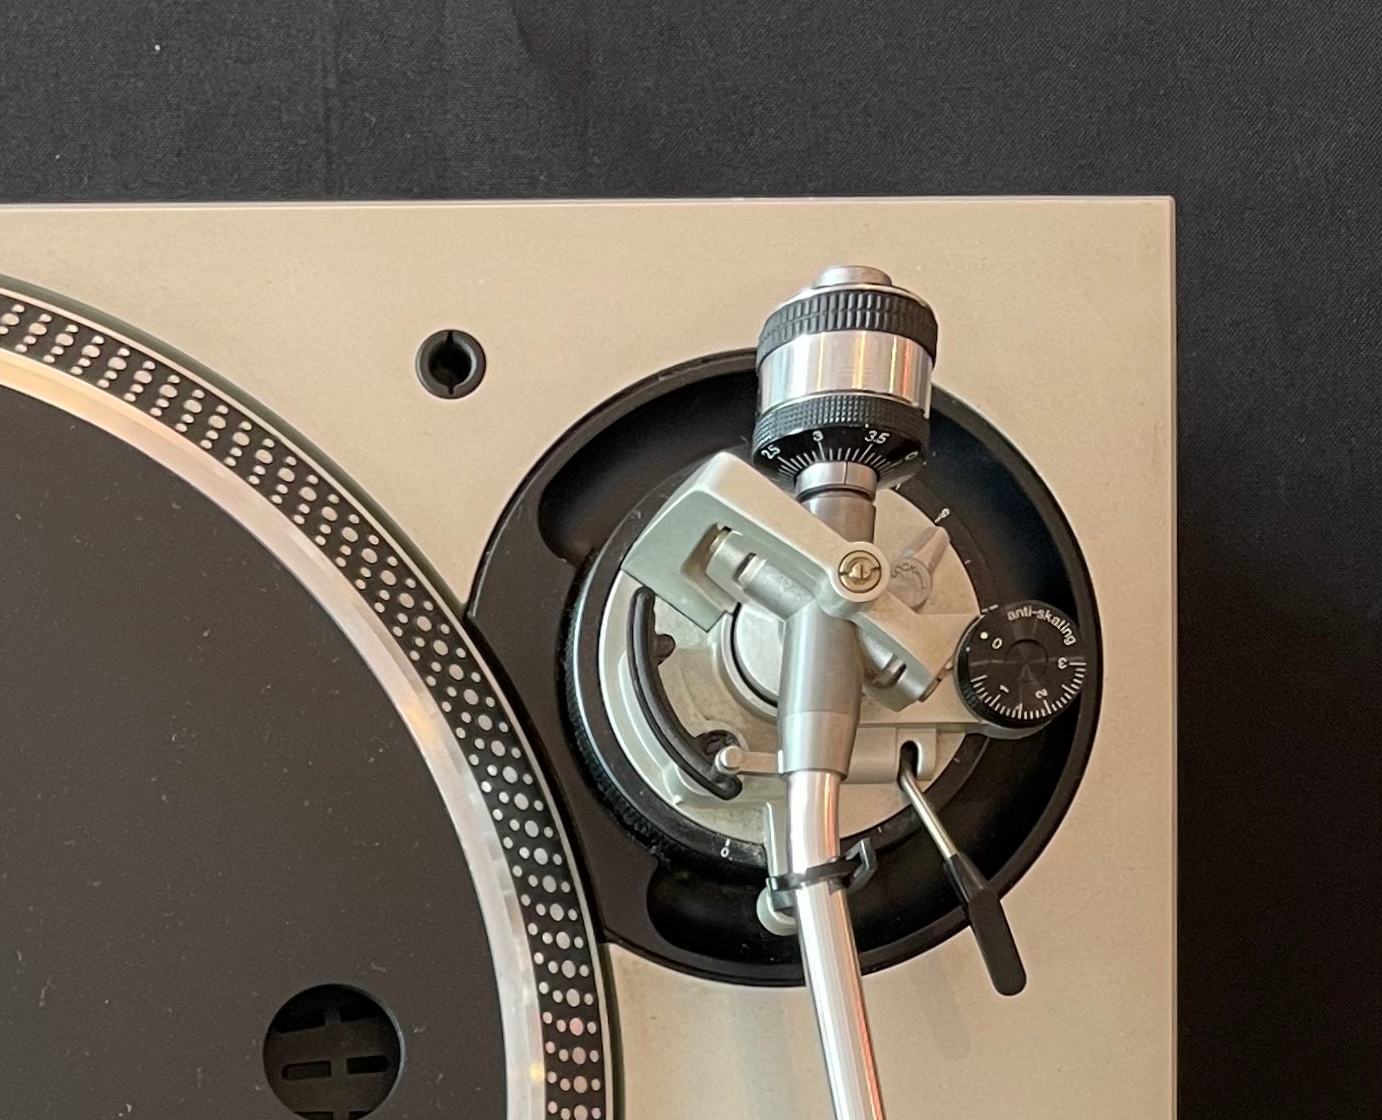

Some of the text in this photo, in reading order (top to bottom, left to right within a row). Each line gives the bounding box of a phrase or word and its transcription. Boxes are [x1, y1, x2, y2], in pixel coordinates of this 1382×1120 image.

[812, 430, 824, 442] 3
[1007, 605, 1077, 646] anti-skating
[991, 637, 1003, 650] 0
[1057, 656, 1068, 669] 3
[999, 684, 1010, 694] 1
[1034, 688, 1048, 699] 2
